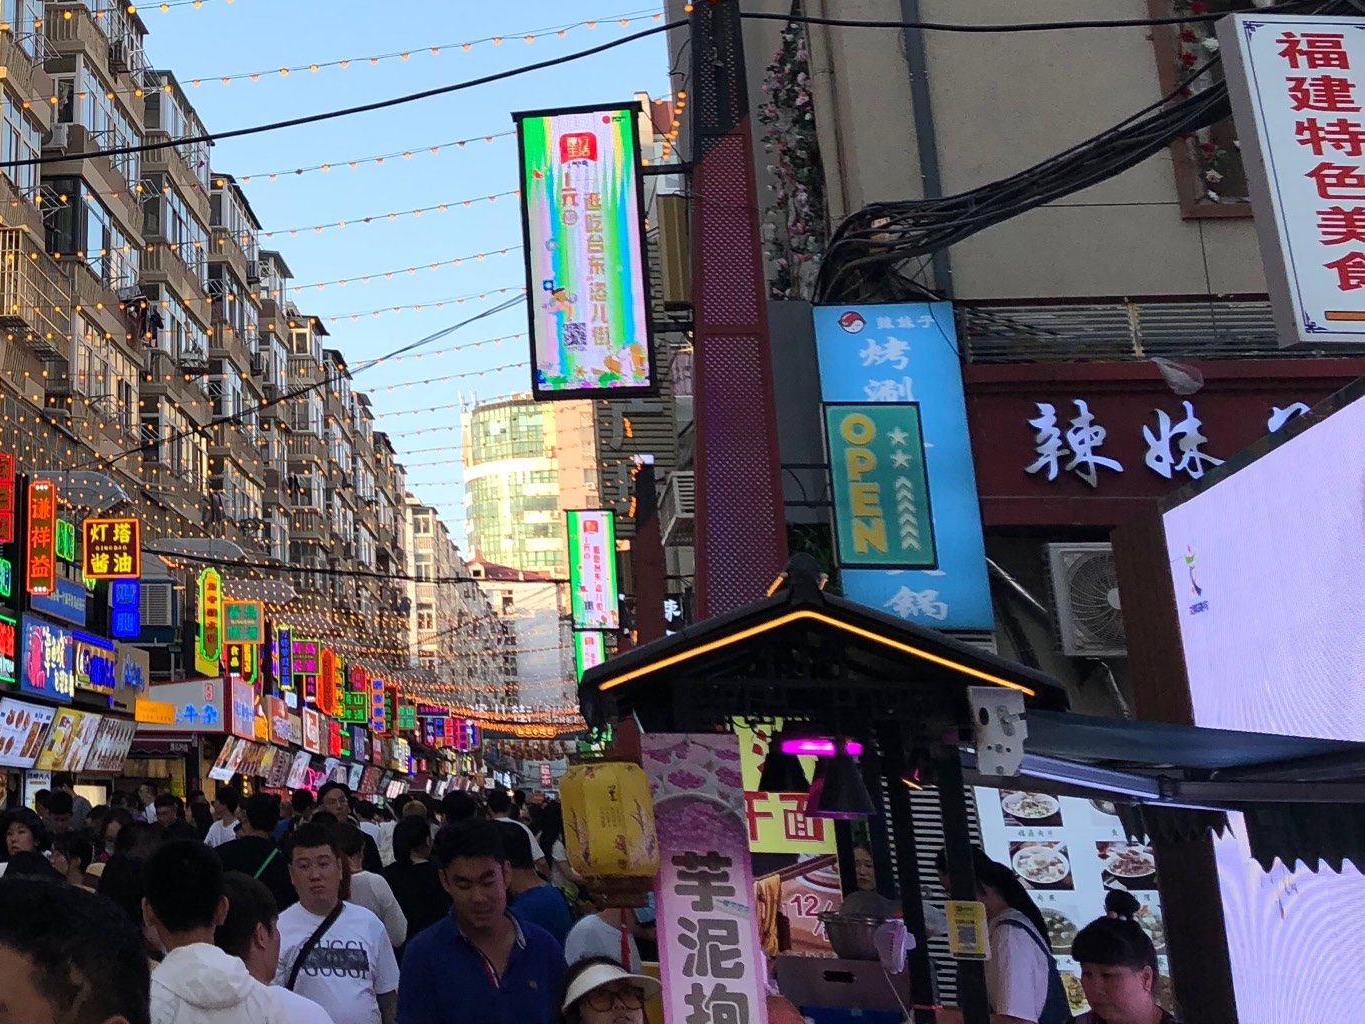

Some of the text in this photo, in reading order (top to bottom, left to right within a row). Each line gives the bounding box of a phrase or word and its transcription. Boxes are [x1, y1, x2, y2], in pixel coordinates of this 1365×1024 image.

[840, 412, 888, 554] OPEN
[30, 497, 52, 578] 谦祥益
[90, 523, 132, 544] 灯塔
[90, 552, 133, 574] 酱油
